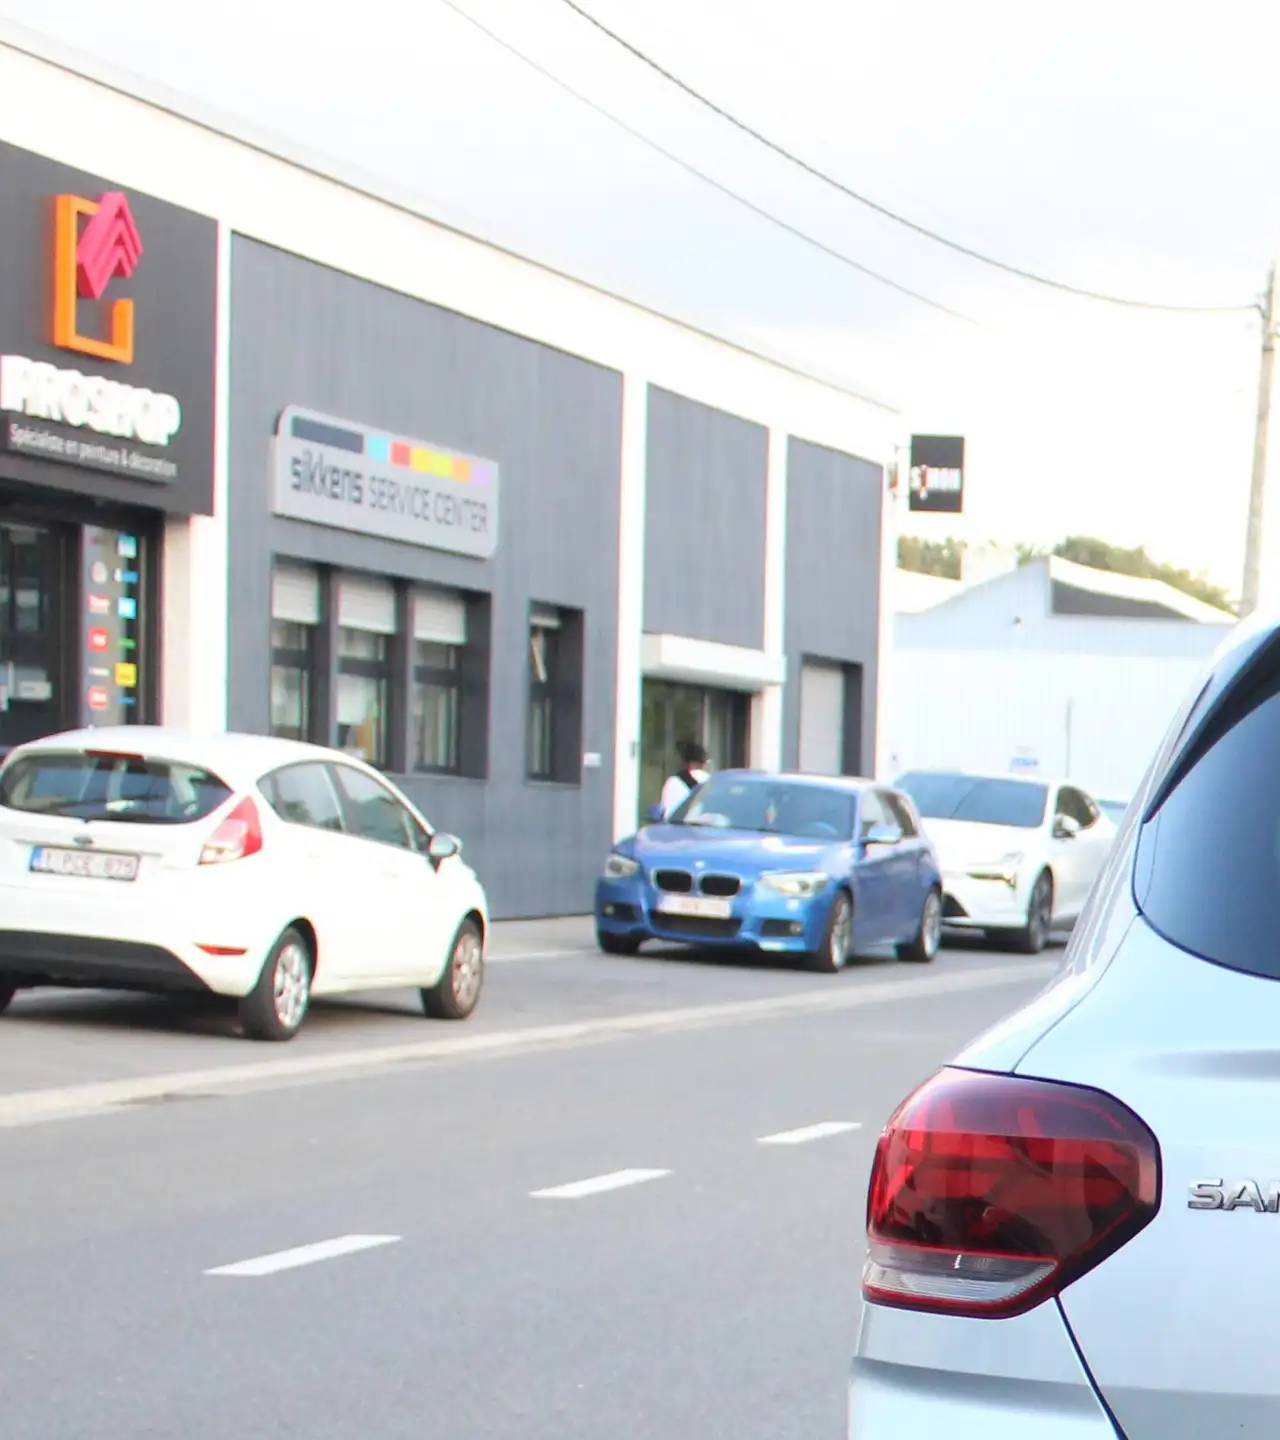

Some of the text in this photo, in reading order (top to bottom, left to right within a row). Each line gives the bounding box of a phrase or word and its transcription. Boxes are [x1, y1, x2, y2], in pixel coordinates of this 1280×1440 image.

[291, 449, 488, 534] sikkens SERVICE CENTER
